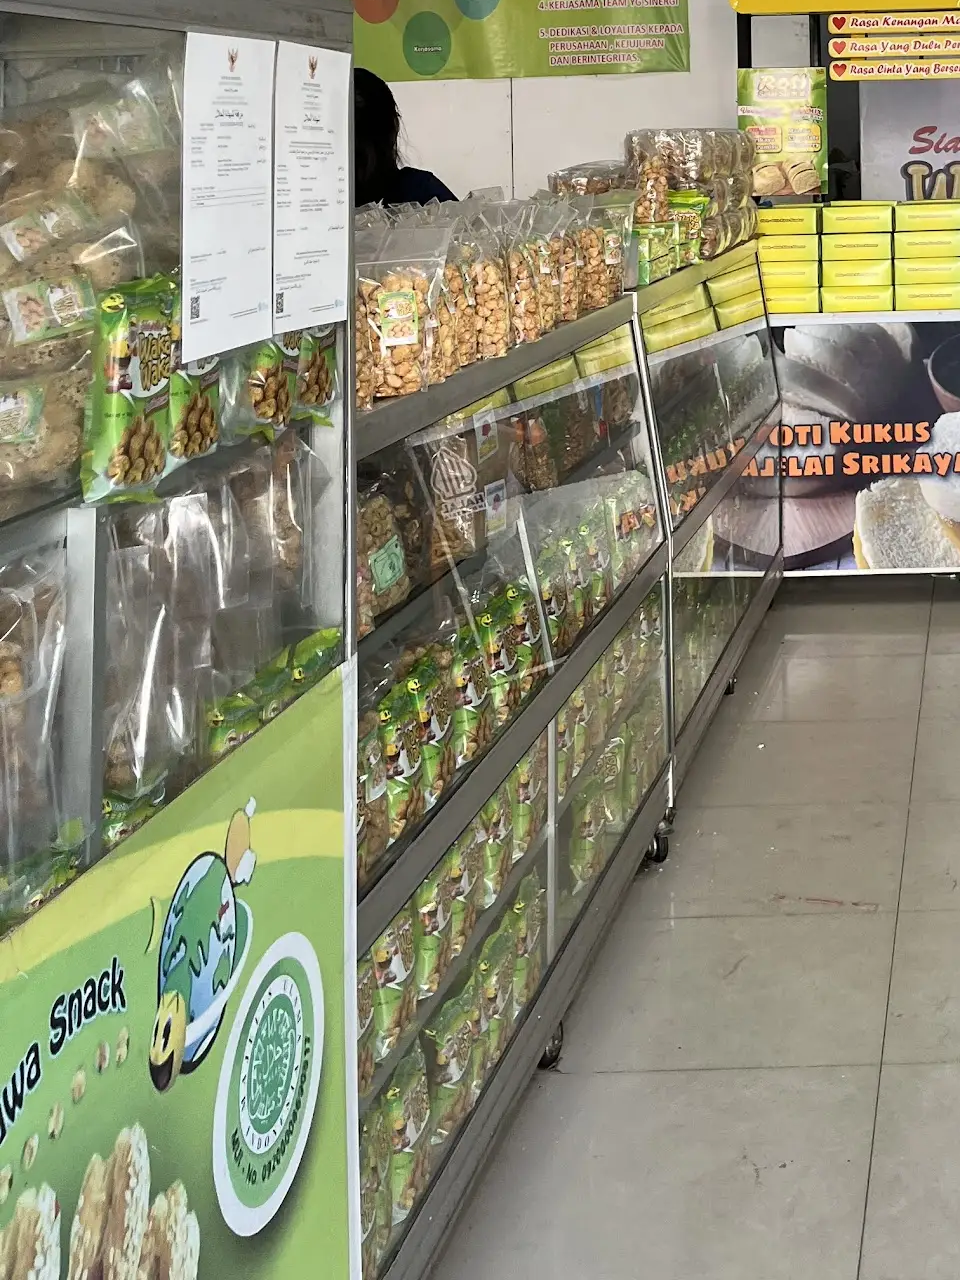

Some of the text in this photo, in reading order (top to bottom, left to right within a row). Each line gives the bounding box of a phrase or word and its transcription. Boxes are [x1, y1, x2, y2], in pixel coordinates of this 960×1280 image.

[549, 0, 599, 9] KERJASAMA
[850, 17, 879, 28] Rasa
[882, 16, 939, 28] Kenangan
[550, 27, 589, 37] DEDIKASI
[600, 25, 646, 35] LOYALITAS
[648, 24, 683, 34] KEPADA
[550, 40, 607, 51] PERUSAHAAN
[615, 39, 664, 49] KEJUJURAN
[850, 42, 877, 52] Rasa
[881, 41, 910, 53] Yang
[913, 40, 941, 50] Dulu
[550, 56, 569, 65] DAN
[850, 65, 874, 75] Rasa
[877, 64, 902, 74] Cinta
[905, 63, 930, 75] Yang
[829, 420, 931, 445] KUKUS
[50, 956, 126, 1056] Snack
